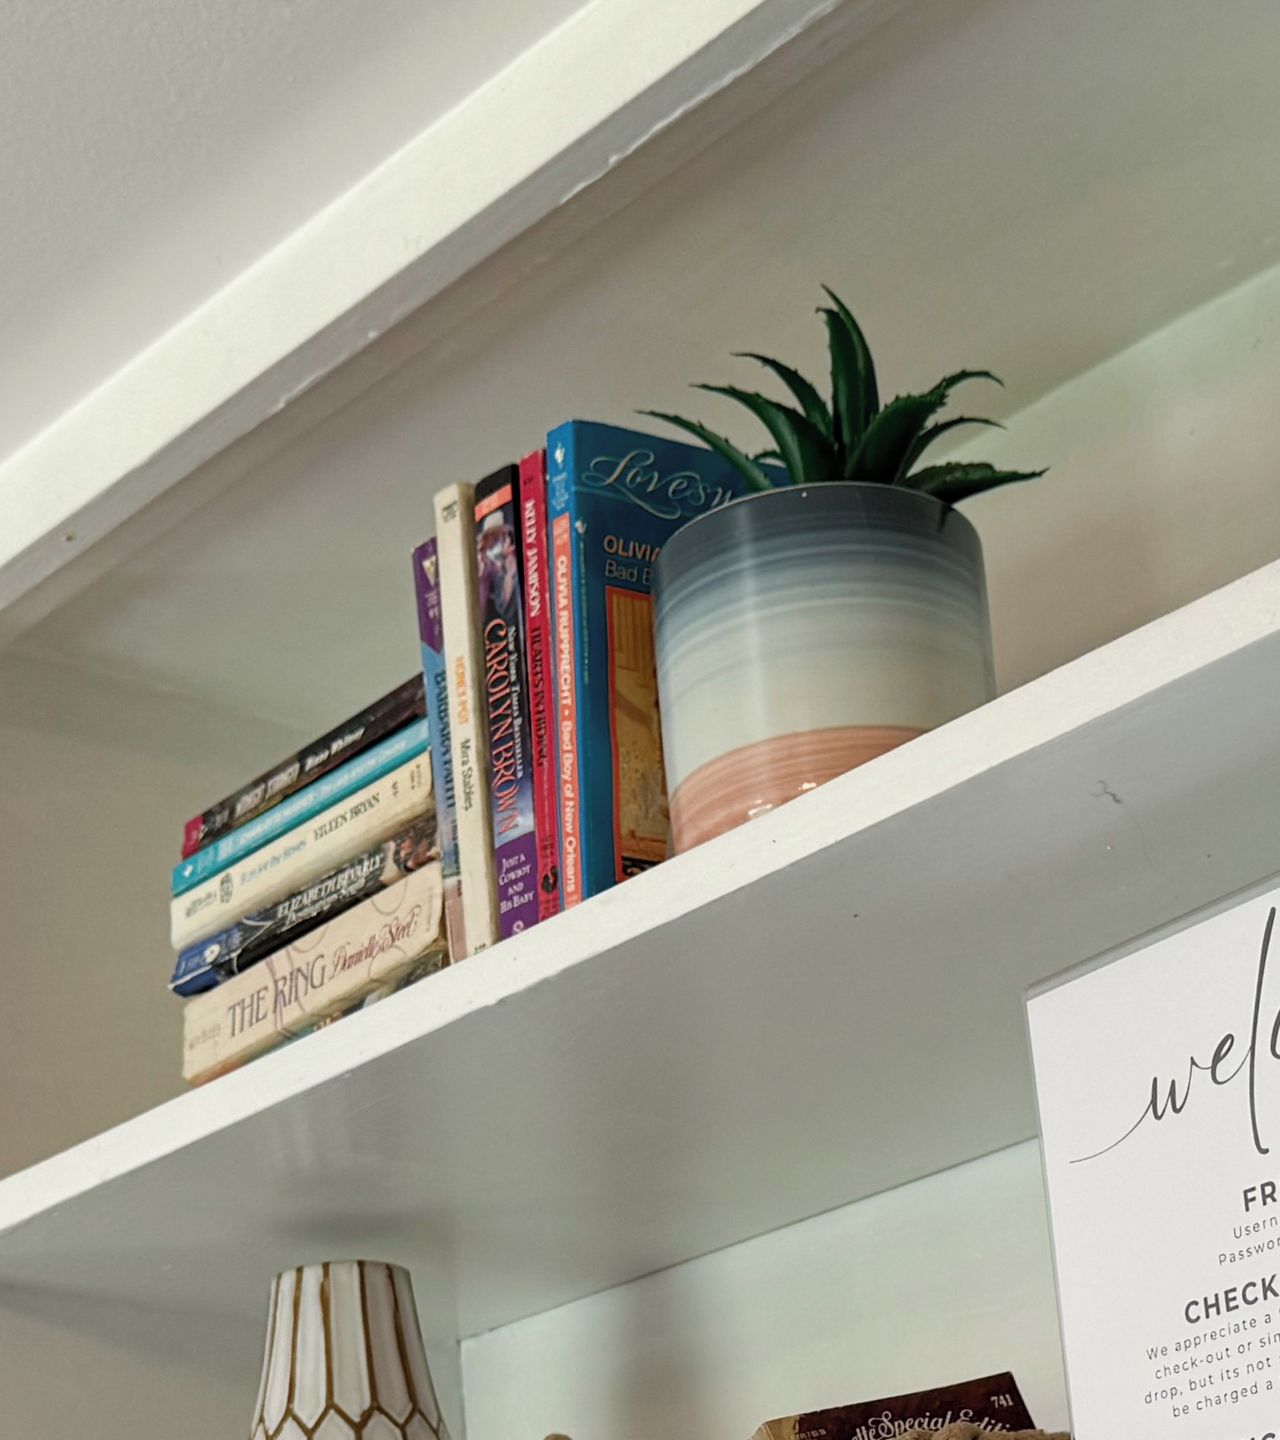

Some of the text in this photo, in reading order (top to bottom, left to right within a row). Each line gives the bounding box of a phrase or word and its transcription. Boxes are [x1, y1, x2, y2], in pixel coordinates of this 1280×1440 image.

[527, 546, 541, 618] JAMISON
[556, 552, 569, 609] OLIVIA
[605, 559, 638, 583] Bad
[558, 609, 571, 707] RUPPRECHT
[482, 618, 520, 835] CAROLYN BROWN
[561, 720, 573, 752] Bad
[461, 765, 475, 812] Stables
[560, 753, 574, 781] Boy
[563, 782, 574, 799] of
[564, 799, 575, 834] New
[565, 835, 577, 894] Orleans
[227, 991, 269, 1038] THE
[273, 954, 326, 1014] RING
[1145, 1346, 1168, 1361] We
[1173, 1317, 1257, 1352] appreciate
[1263, 1313, 1272, 1325] a
[1154, 1347, 1231, 1380] check-out
[1236, 1341, 1252, 1355] or
[989, 1393, 1014, 1408] 741
[1143, 1386, 1183, 1405] drop,
[1187, 1374, 1214, 1392] but
[1219, 1367, 1240, 1382] its
[1245, 1356, 1272, 1375] not
[1171, 1404, 1190, 1418] be
[1194, 1381, 1259, 1411] charged
[1264, 1380, 1274, 1391] a
